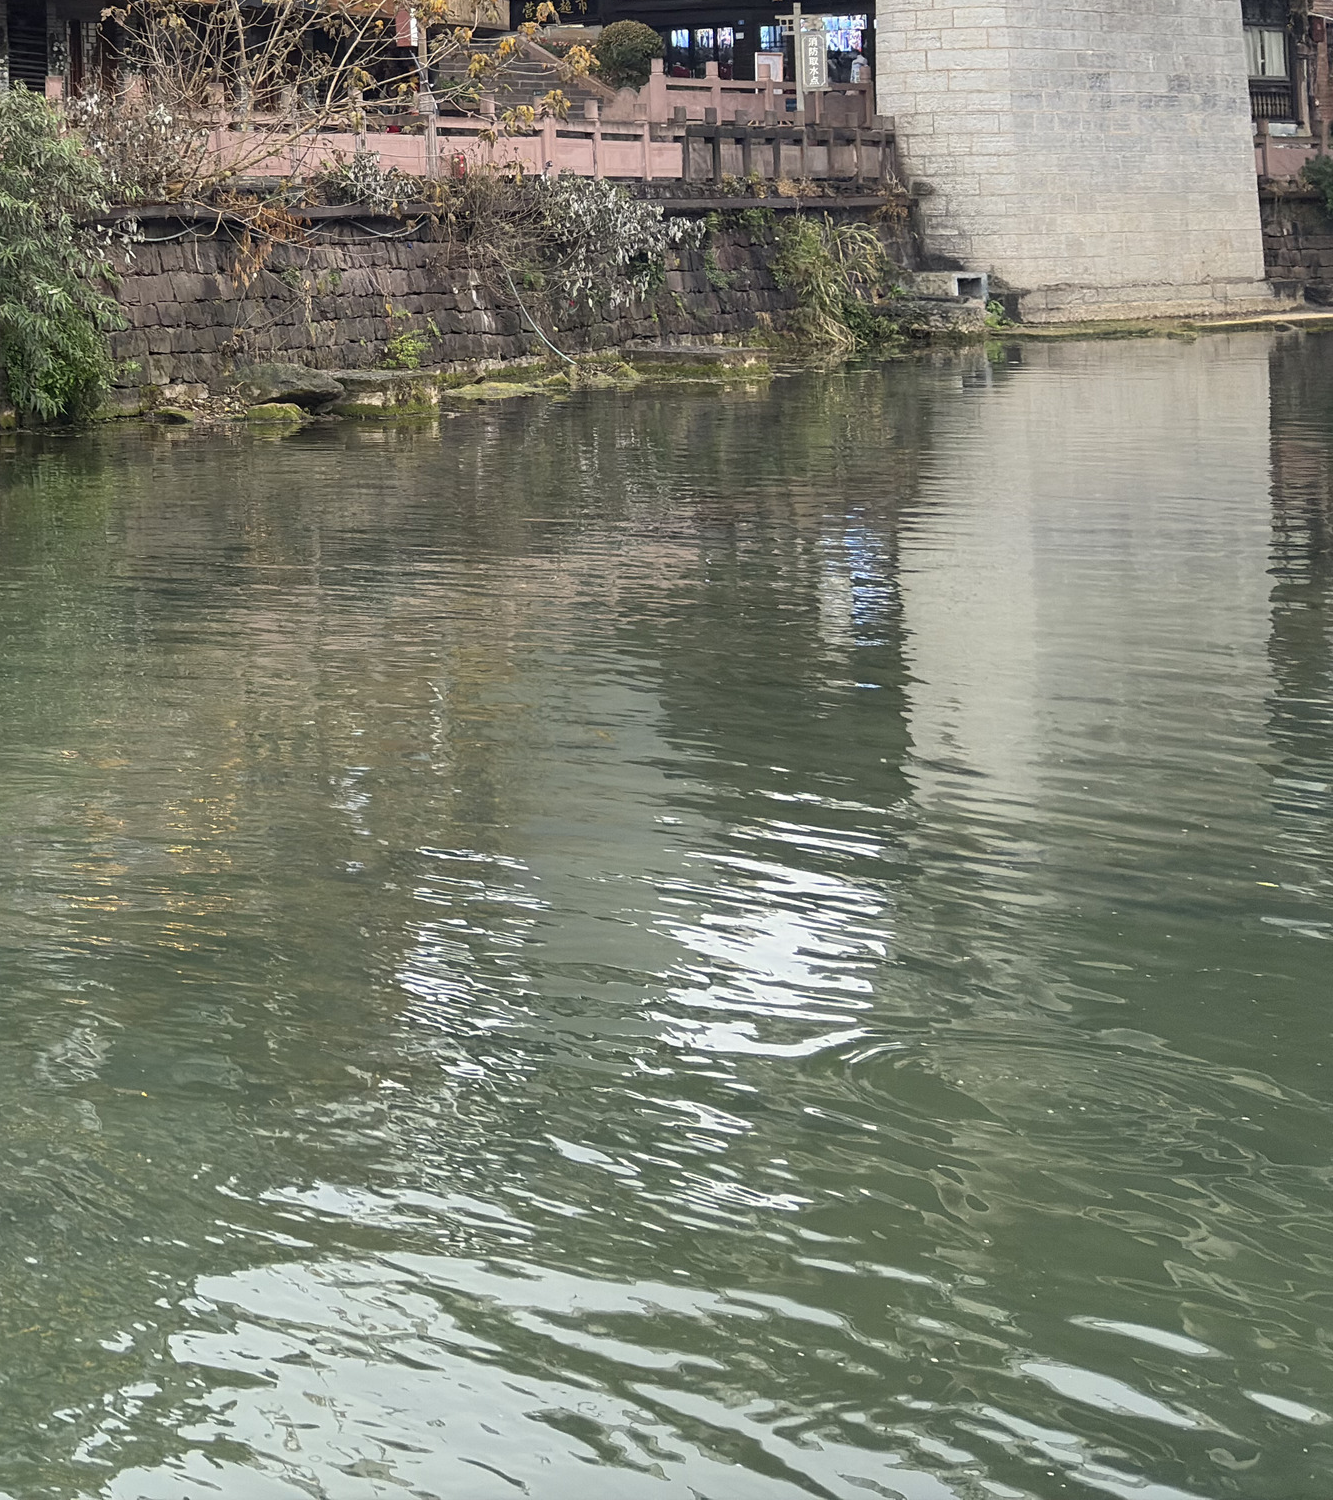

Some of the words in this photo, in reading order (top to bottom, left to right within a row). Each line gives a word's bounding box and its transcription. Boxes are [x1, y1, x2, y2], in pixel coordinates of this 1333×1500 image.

[808, 37, 820, 85] 消防取水点
